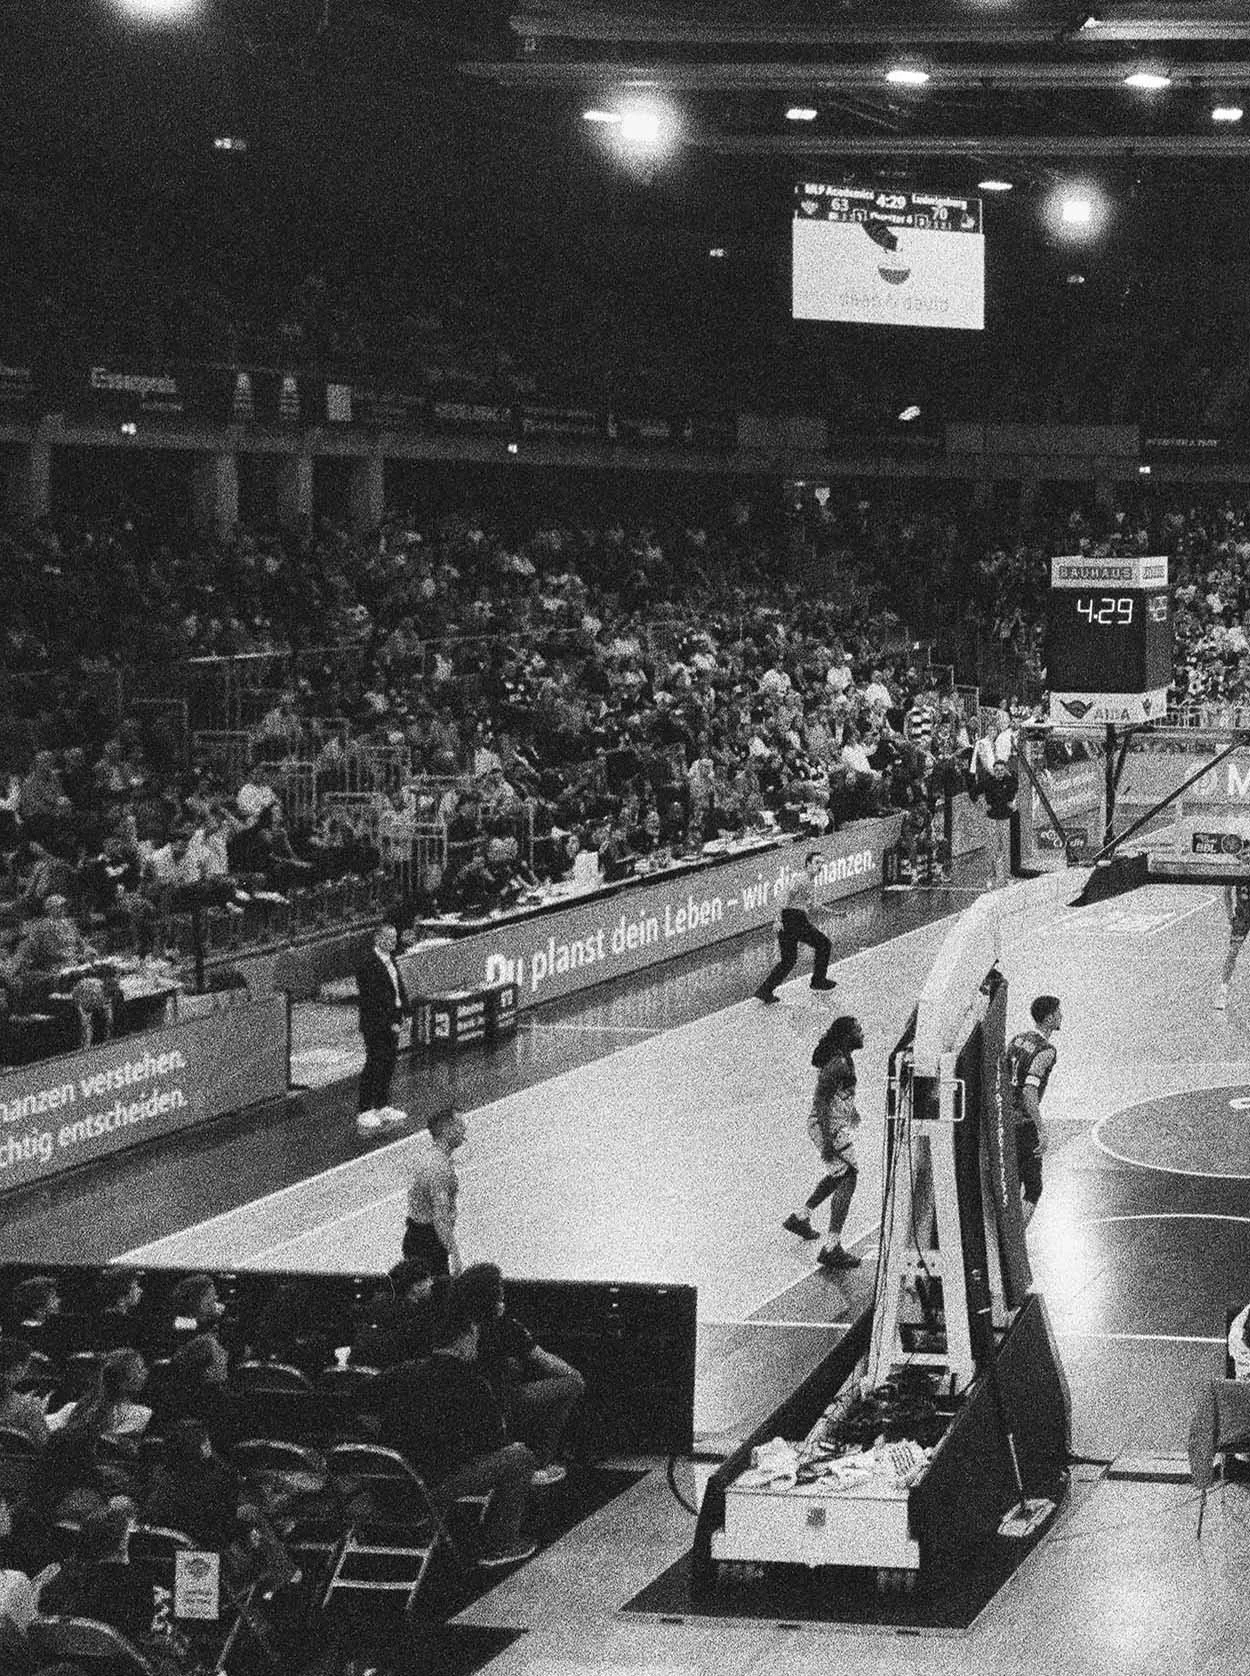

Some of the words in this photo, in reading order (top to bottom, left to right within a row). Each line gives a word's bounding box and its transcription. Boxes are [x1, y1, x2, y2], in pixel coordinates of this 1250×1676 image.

[831, 198, 848, 211] 63
[876, 194, 907, 209] 4:29
[931, 206, 948, 220] 70
[1058, 566, 1133, 580] BAUHAUS
[532, 929, 606, 992] planst
[611, 912, 659, 954] dein
[664, 890, 723, 938] Leben
[742, 875, 770, 908] wir
[80, 1050, 186, 1098] verstehen.
[58, 1088, 188, 1147] entscheiden.
